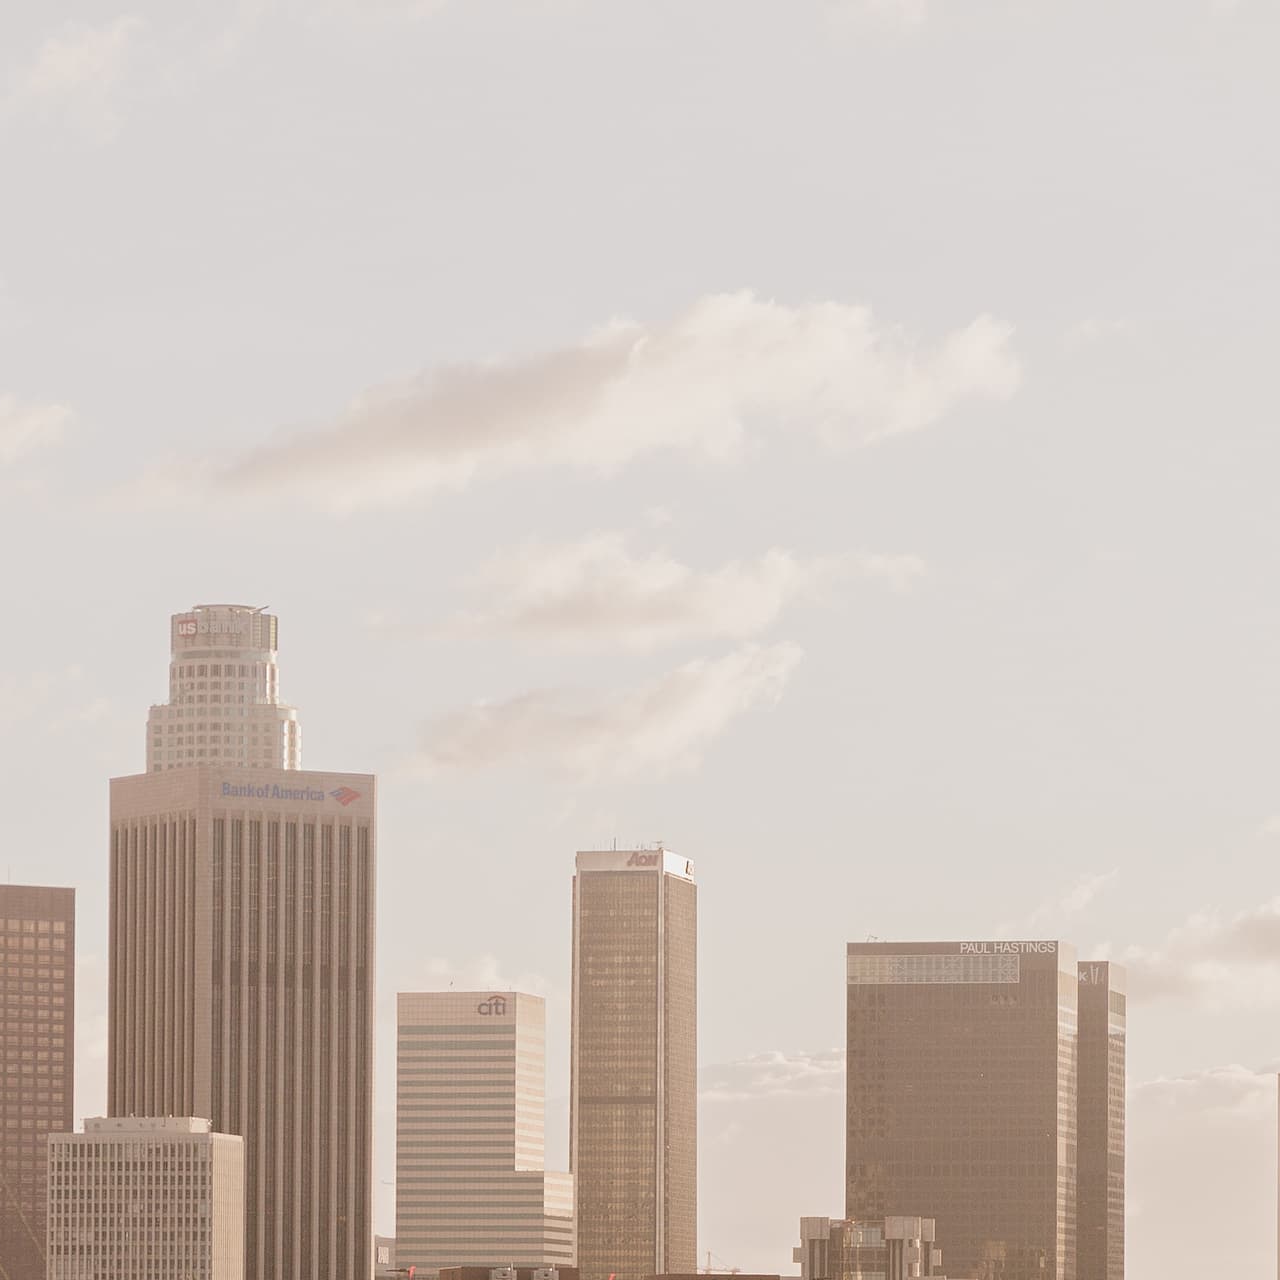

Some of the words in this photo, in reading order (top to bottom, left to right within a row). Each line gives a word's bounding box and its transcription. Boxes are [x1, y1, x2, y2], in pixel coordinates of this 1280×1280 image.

[222, 782, 255, 798] Bank
[256, 784, 269, 799] of
[272, 784, 325, 801] America
[960, 942, 990, 954] PAUL
[993, 942, 1056, 954] HASTINGS
[478, 995, 506, 1016] citi
